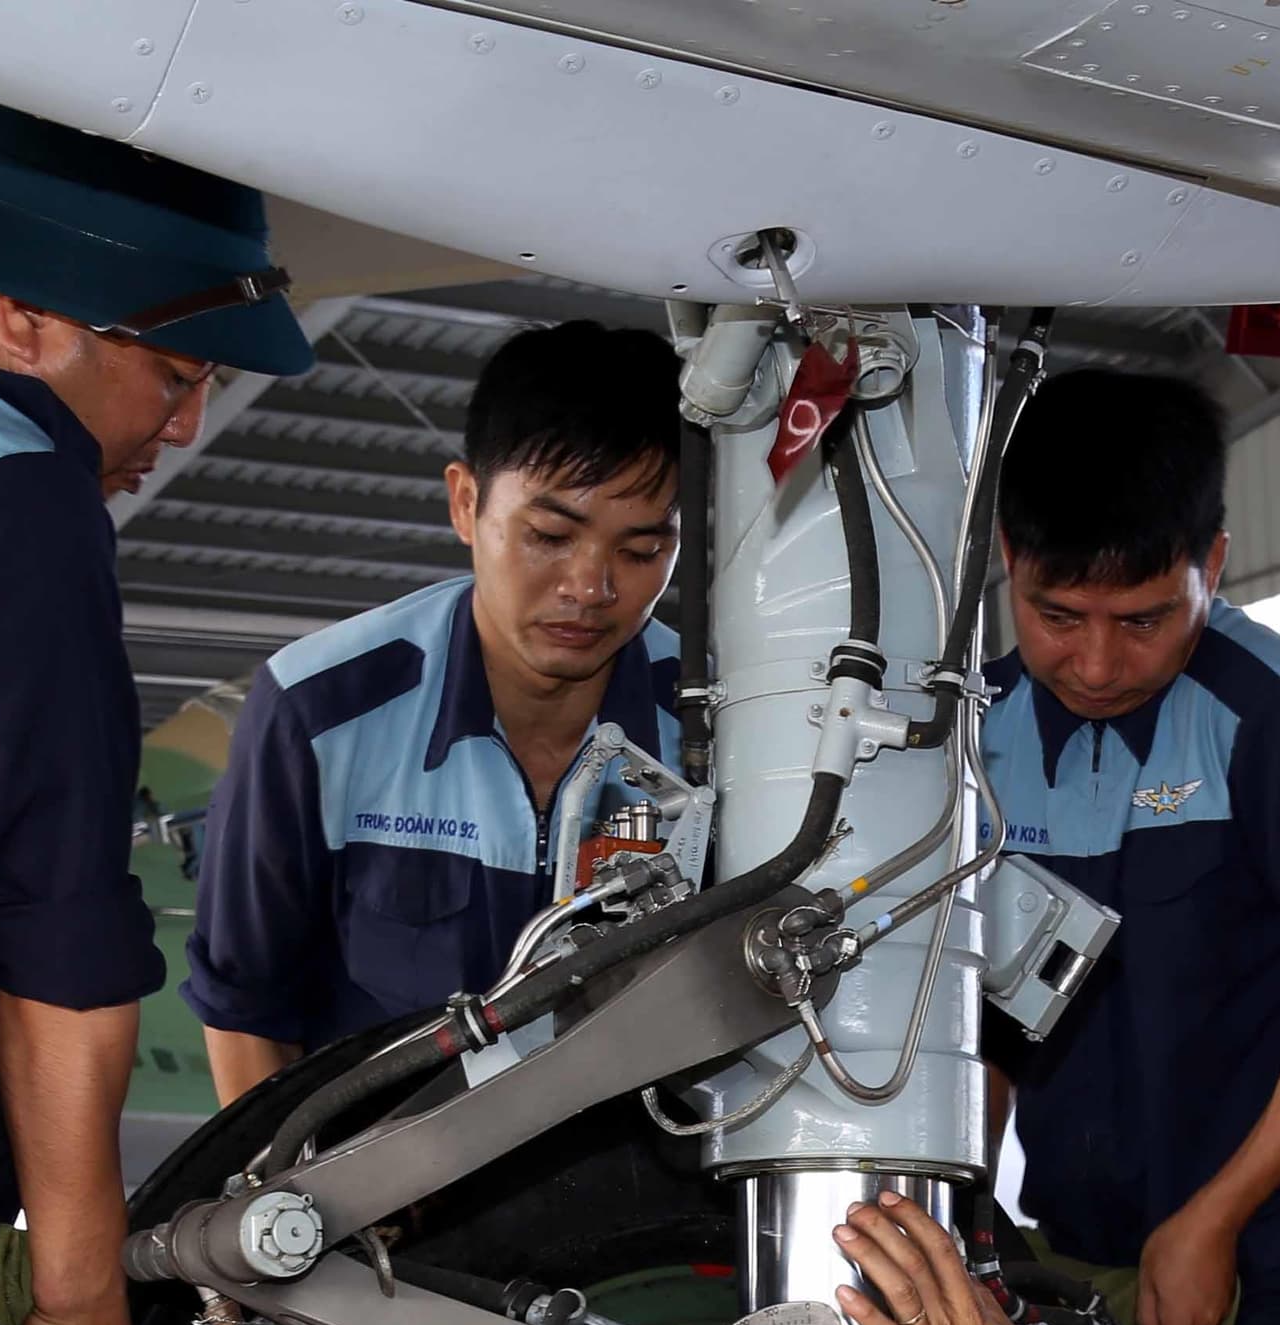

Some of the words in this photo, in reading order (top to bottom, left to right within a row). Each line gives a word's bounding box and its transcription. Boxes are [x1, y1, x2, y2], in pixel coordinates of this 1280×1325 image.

[394, 812, 434, 835] ĐOÀN
[438, 818, 458, 836] KQ
[1020, 825, 1037, 843] KQ
